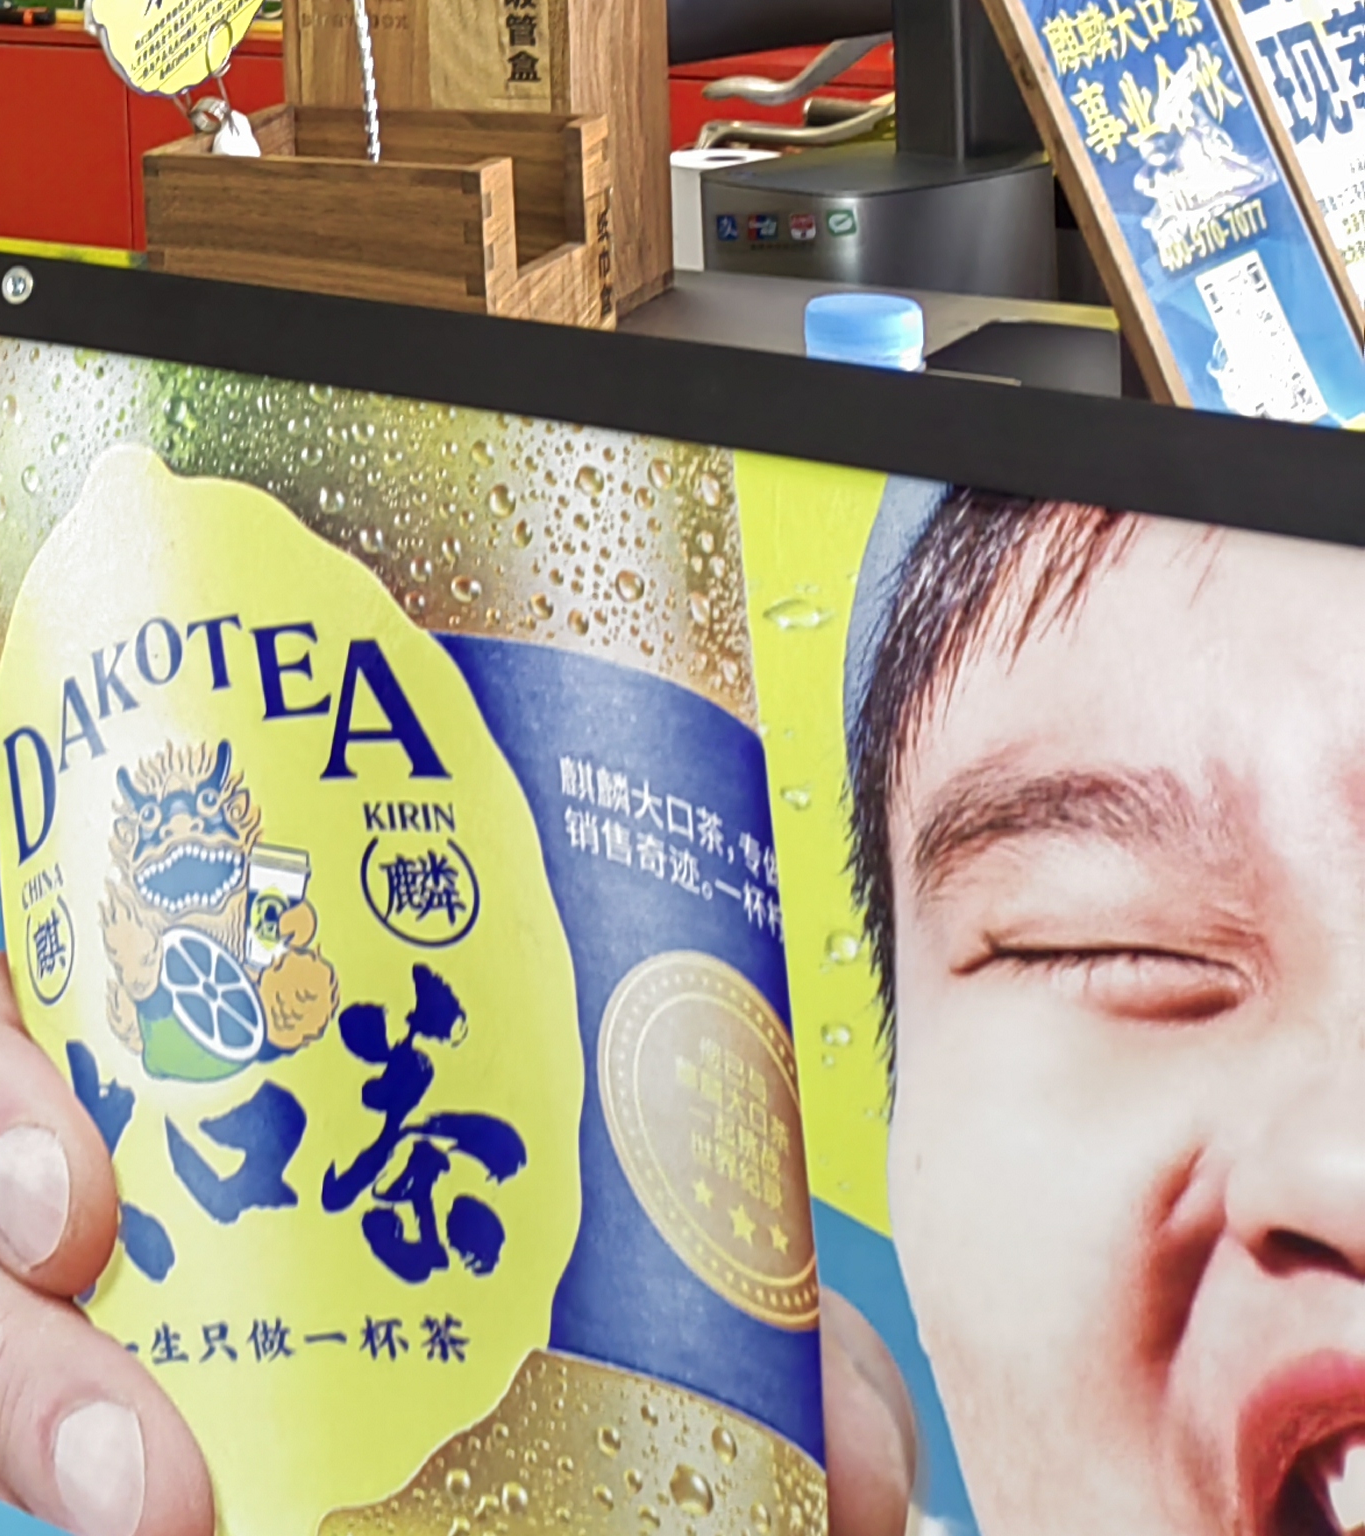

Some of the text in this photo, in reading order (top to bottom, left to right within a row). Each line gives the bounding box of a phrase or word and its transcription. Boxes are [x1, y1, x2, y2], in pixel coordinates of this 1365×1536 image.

[3, 614, 453, 867] DAKOTEA
[363, 800, 457, 833] KIRIN
[21, 863, 65, 912] CHINA
